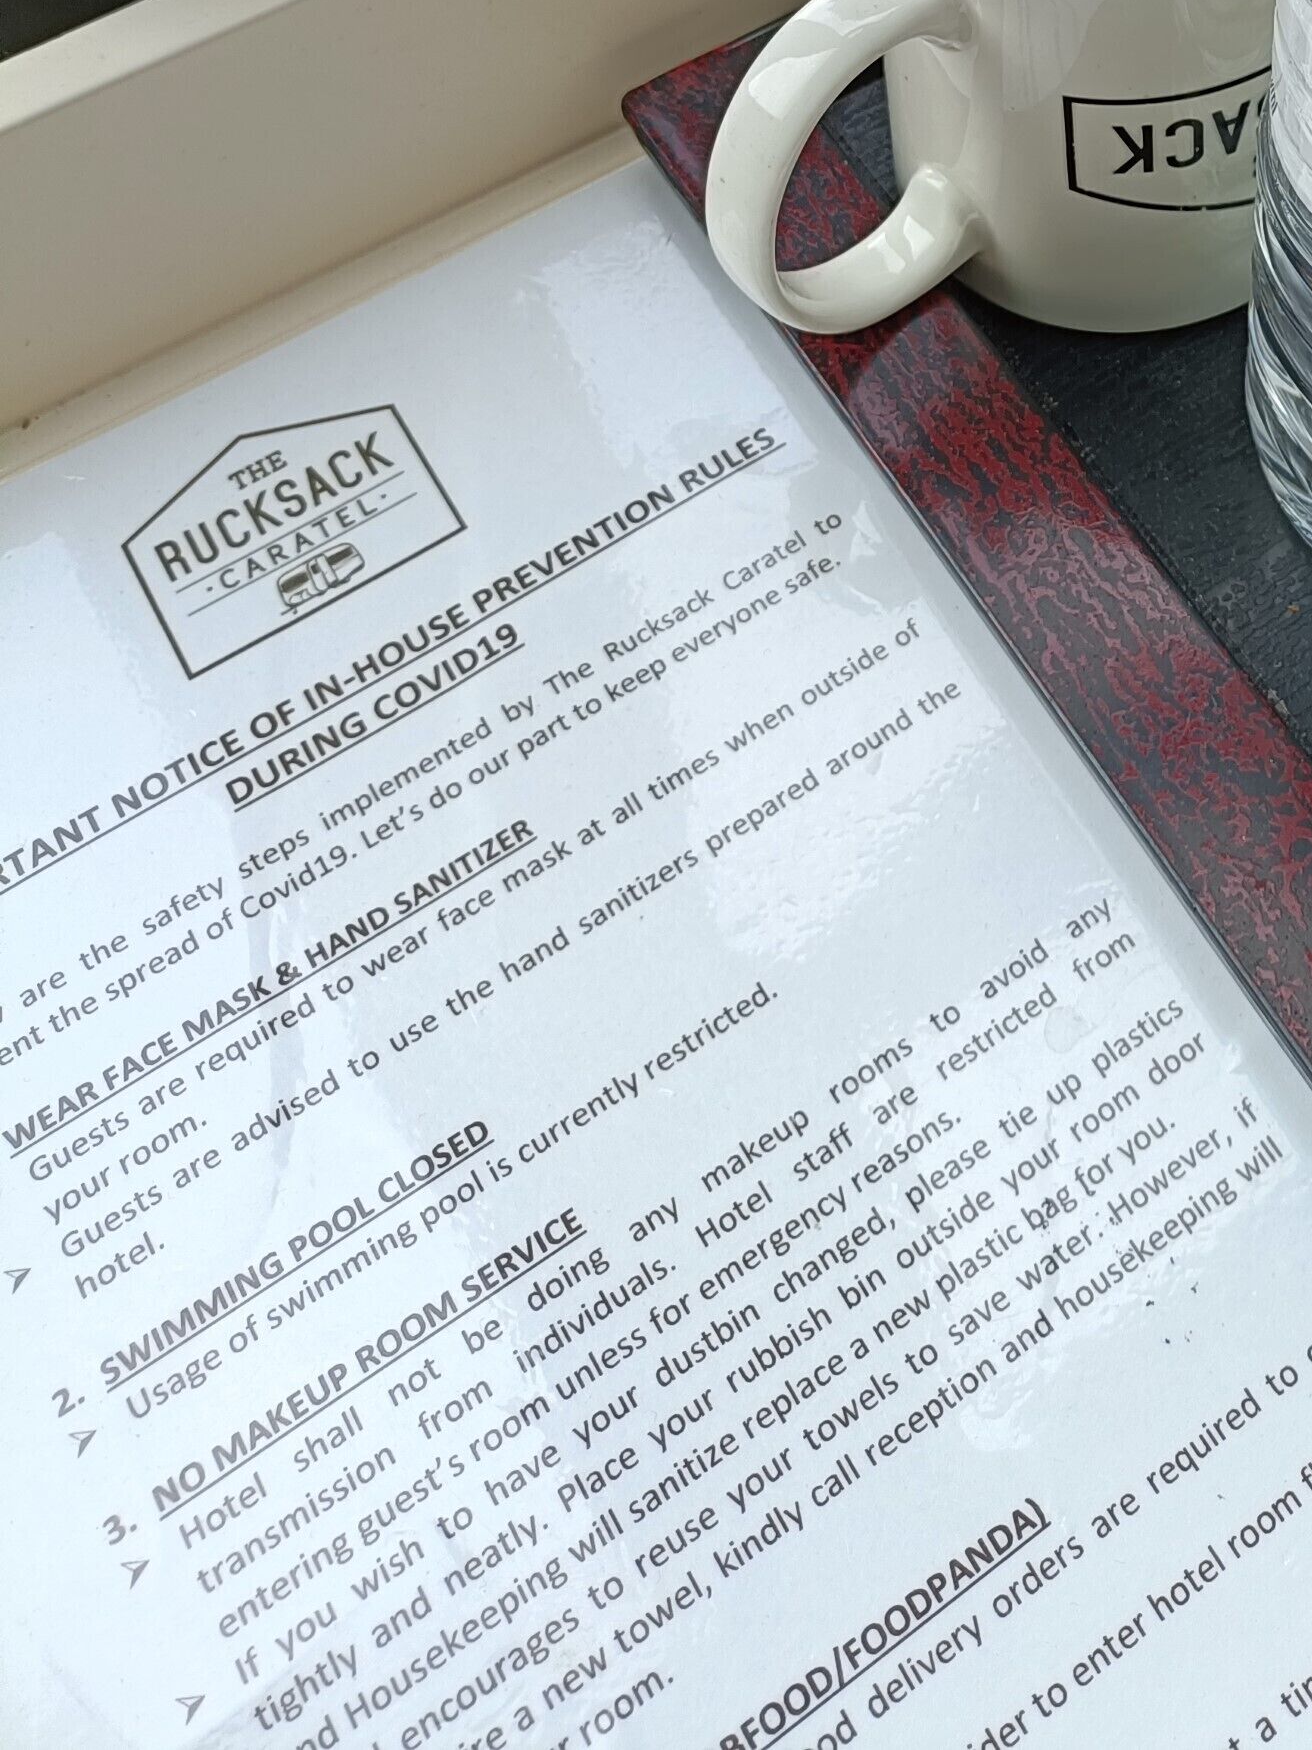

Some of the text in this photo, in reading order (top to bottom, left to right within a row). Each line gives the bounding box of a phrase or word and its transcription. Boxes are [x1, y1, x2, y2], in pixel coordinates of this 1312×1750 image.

[110, 728, 246, 820] NOTICE
[249, 698, 296, 740] OF
[302, 602, 471, 712] IN-HOUSE
[471, 483, 677, 615] PREVENTION
[677, 427, 776, 494] RULES
[153, 430, 395, 583] RUCKSACK
[218, 498, 379, 590] CARATEL
[226, 449, 289, 491] THE
[18, 513, 843, 1009] are the safety steps implemented by The Rucksack Caratel to
[47, 995, 100, 1034] the
[104, 928, 201, 1003] spread
[205, 906, 234, 941] of
[239, 844, 358, 919] Covid19.
[359, 803, 425, 850] Let's
[428, 781, 463, 810] do
[468, 748, 510, 786] our
[516, 714, 573, 762] part
[571, 697, 603, 722] to
[602, 658, 668, 703] keep
[671, 589, 783, 663] everyone
[784, 557, 842, 595] safe.
[224, 622, 519, 806] DURING COVID19
[1, 819, 535, 1150] WEAR FACE MASK & HAND SANITIZER
[28, 617, 920, 1182] Guests are required to wear face mask at all times when outside of
[42, 1115, 208, 1226] your room.
[50, 1120, 489, 1419] 2. SWIMMING POOL CLOSED
[125, 980, 779, 1419] Usage of swimming pool is currently restricted.
[178, 897, 1112, 1550] Hotel shall not be doing any makeup rooms to avoid any
[102, 1206, 584, 1546] 3. NO MAKEUP ROOM SERVICE
[218, 1111, 962, 1638] entering guest's room unless for emergency reasons.
[867, 1614, 983, 1720] delivery
[991, 1535, 1085, 1619] orders
[1090, 1492, 1141, 1540] are
[1145, 1386, 1263, 1495] required
[1264, 1364, 1299, 1397] to
[1030, 1681, 1069, 1719] to
[1072, 1612, 1147, 1687] enter
[1145, 1544, 1227, 1623] hotel
[1226, 1489, 1303, 1560] room
[1254, 1716, 1278, 1744] a
